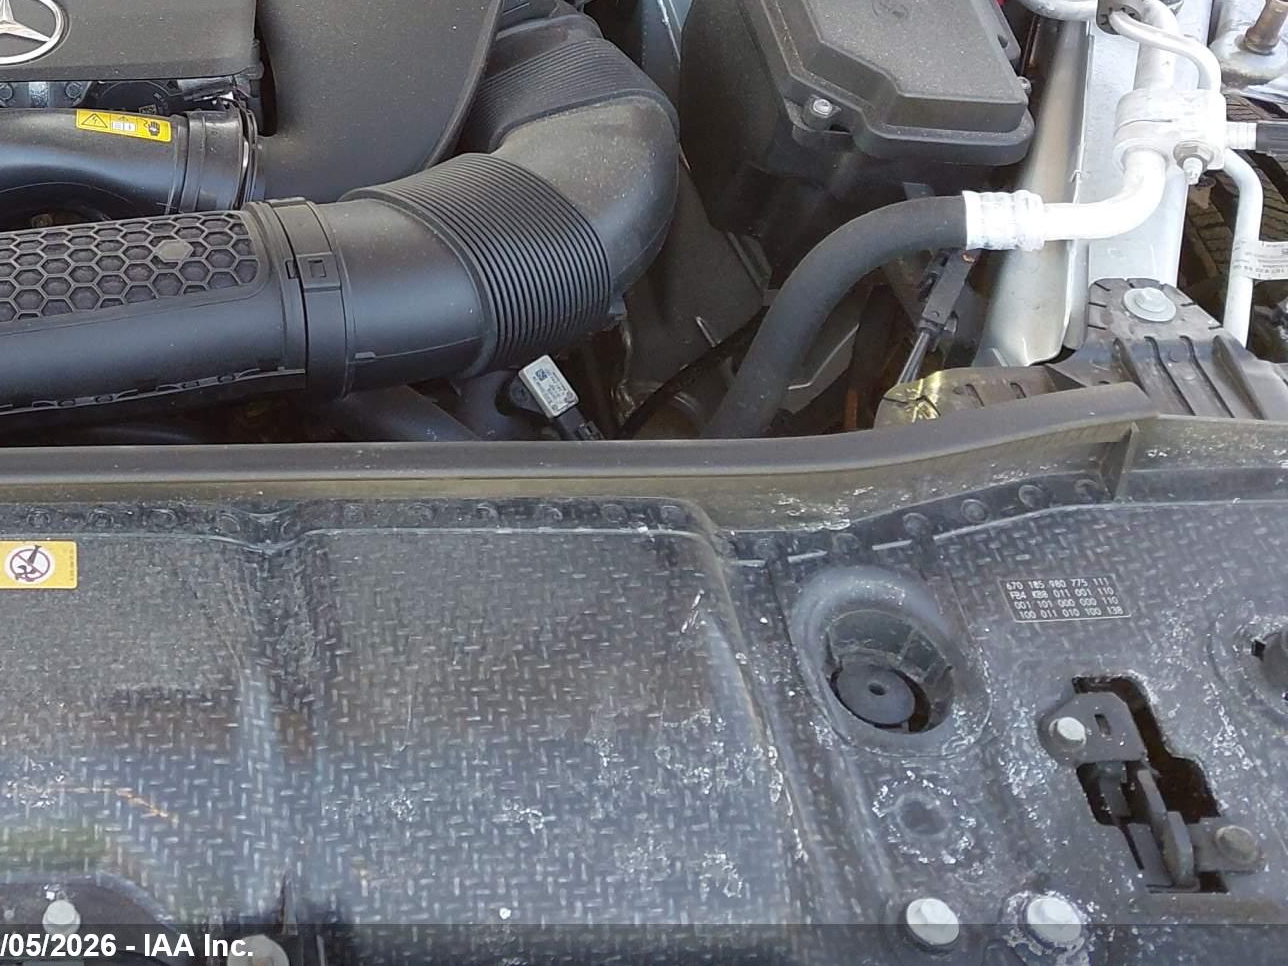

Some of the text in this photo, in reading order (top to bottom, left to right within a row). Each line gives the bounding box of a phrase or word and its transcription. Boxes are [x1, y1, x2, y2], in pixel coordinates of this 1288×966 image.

[1070, 578, 1089, 587] 775
[1092, 577, 1110, 586] 111
[1052, 589, 1071, 598] 011
[1074, 588, 1093, 597] 001
[1097, 587, 1114, 595] 110
[1014, 596, 1119, 610] 001 101 000 000 110
[1018, 611, 1036, 619] 100
[1040, 610, 1058, 618] 011
[1062, 608, 1080, 617] 010
[1084, 607, 1102, 616] 100
